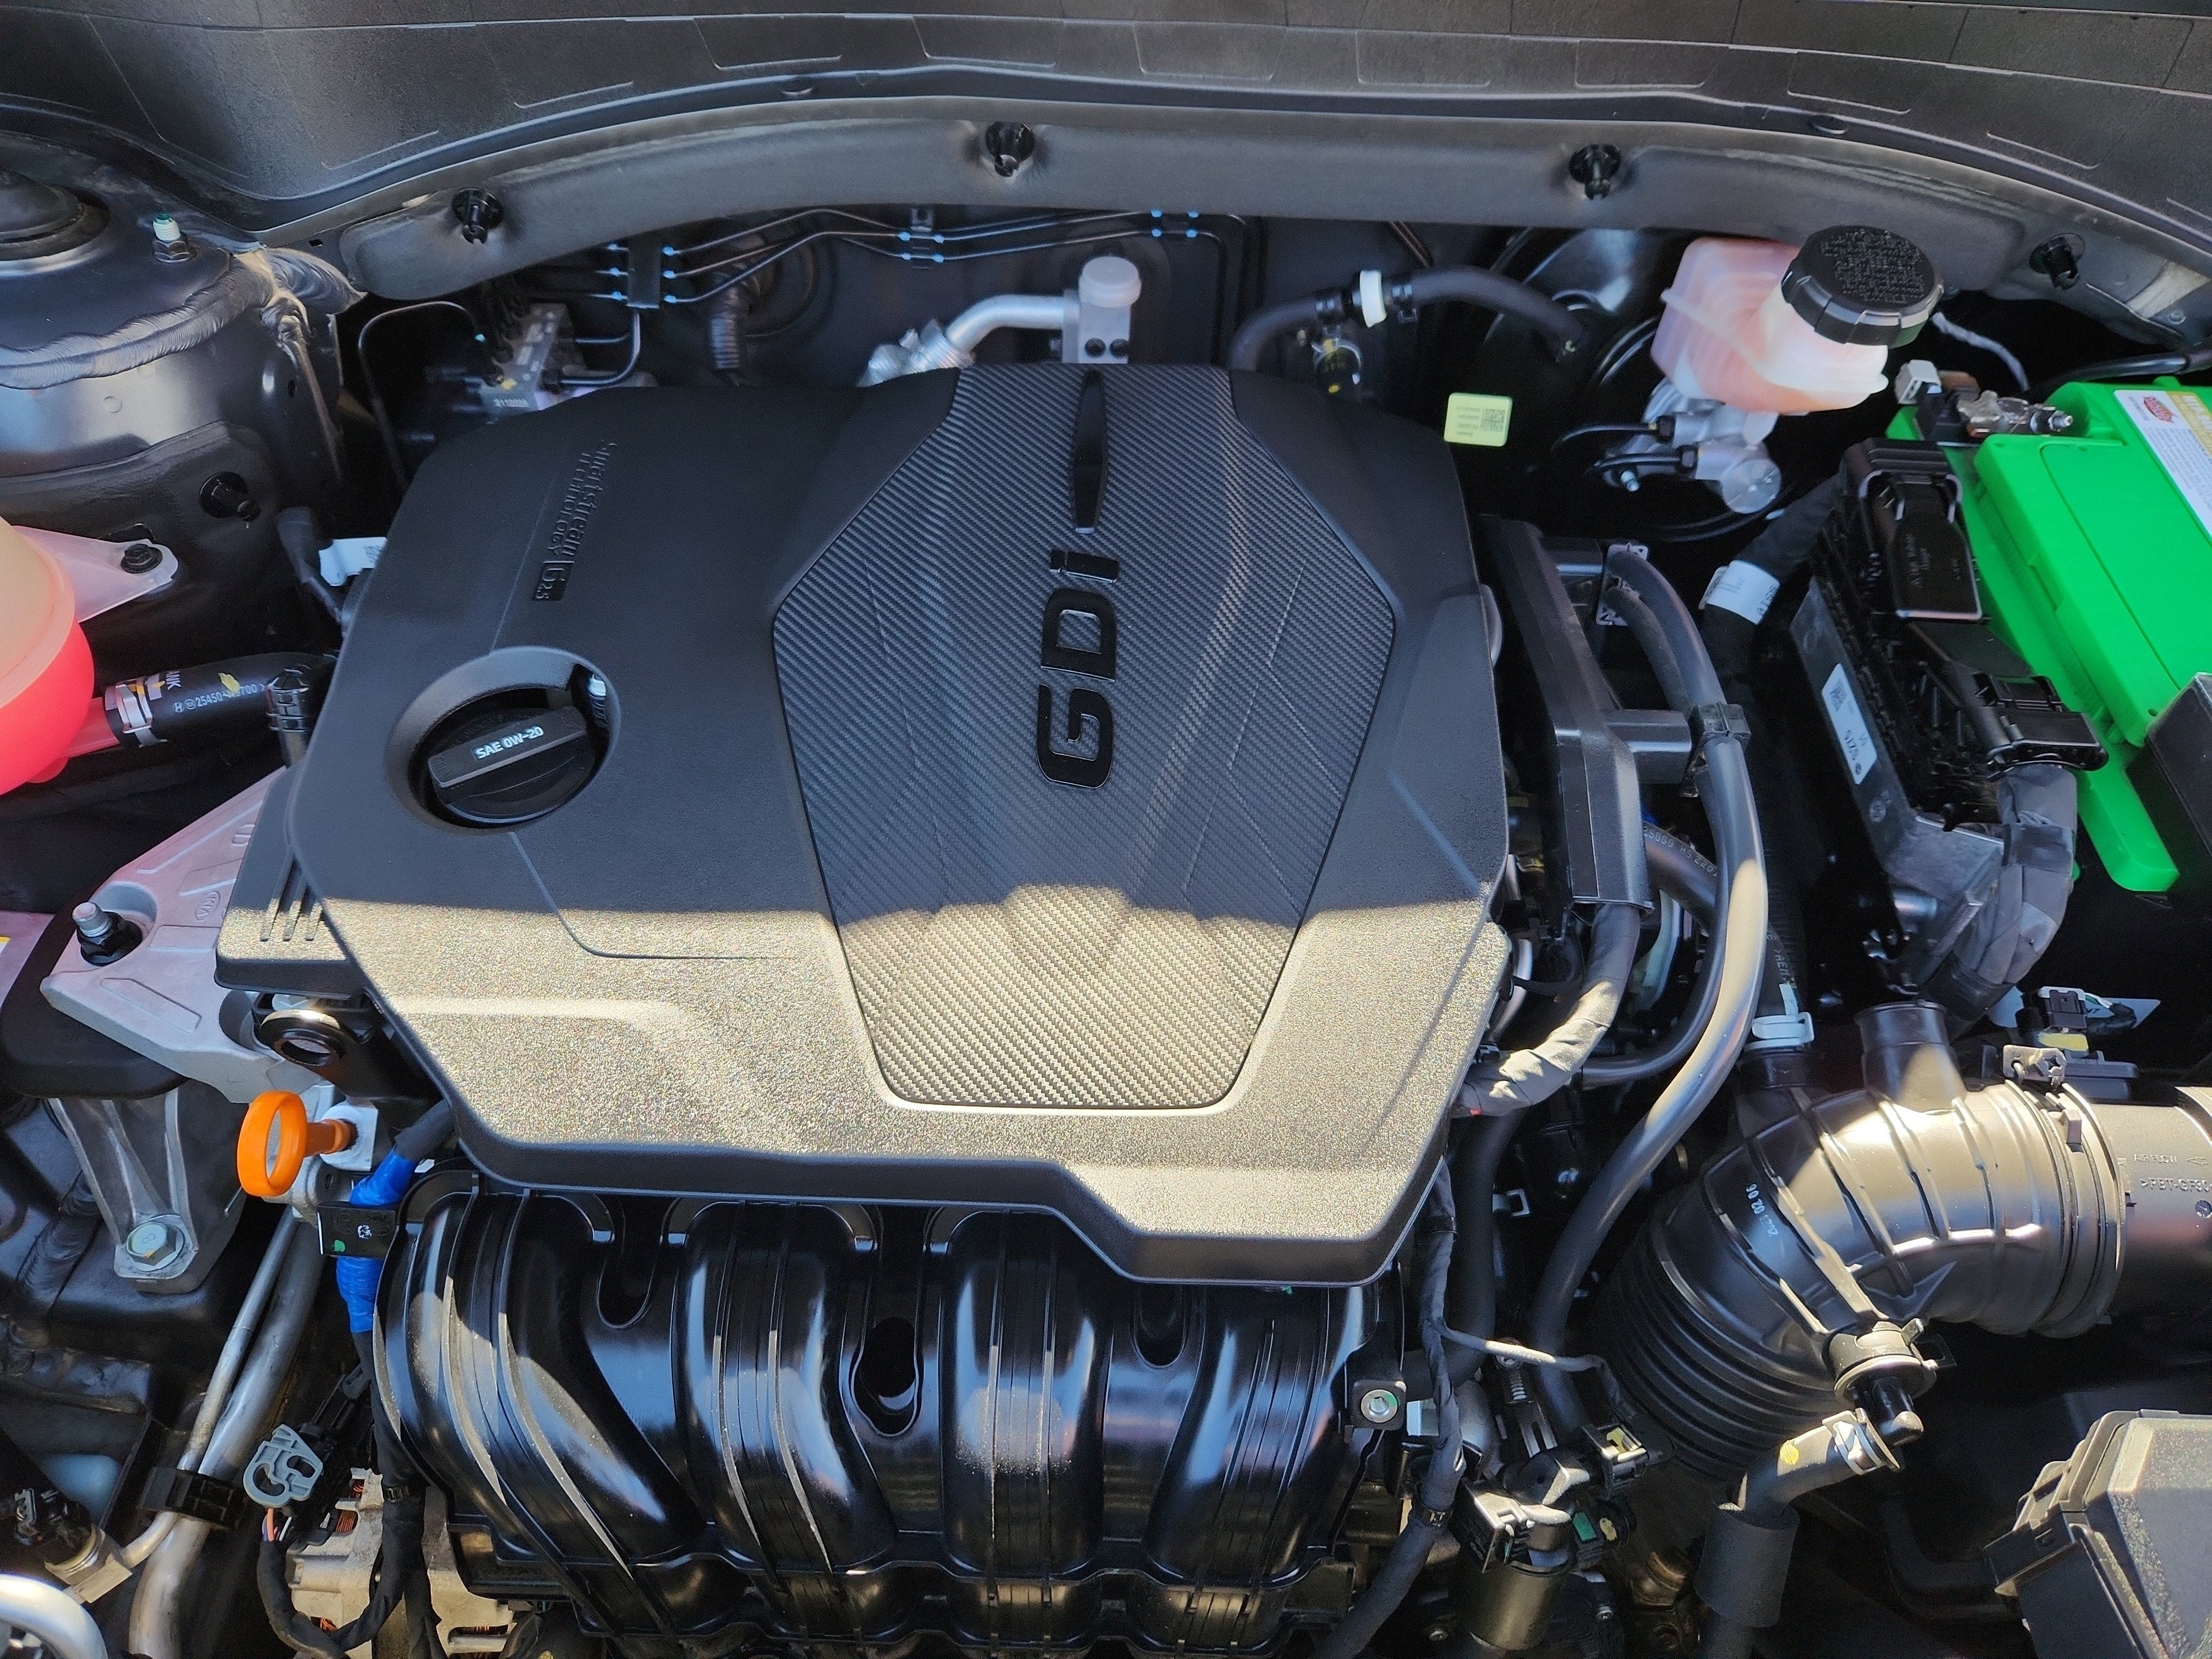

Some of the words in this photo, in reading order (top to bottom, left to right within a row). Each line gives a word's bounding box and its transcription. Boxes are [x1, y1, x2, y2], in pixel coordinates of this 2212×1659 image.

[1036, 549, 1120, 789] GDi
[475, 741, 504, 759] SAE
[501, 725, 544, 749] 0W-20
